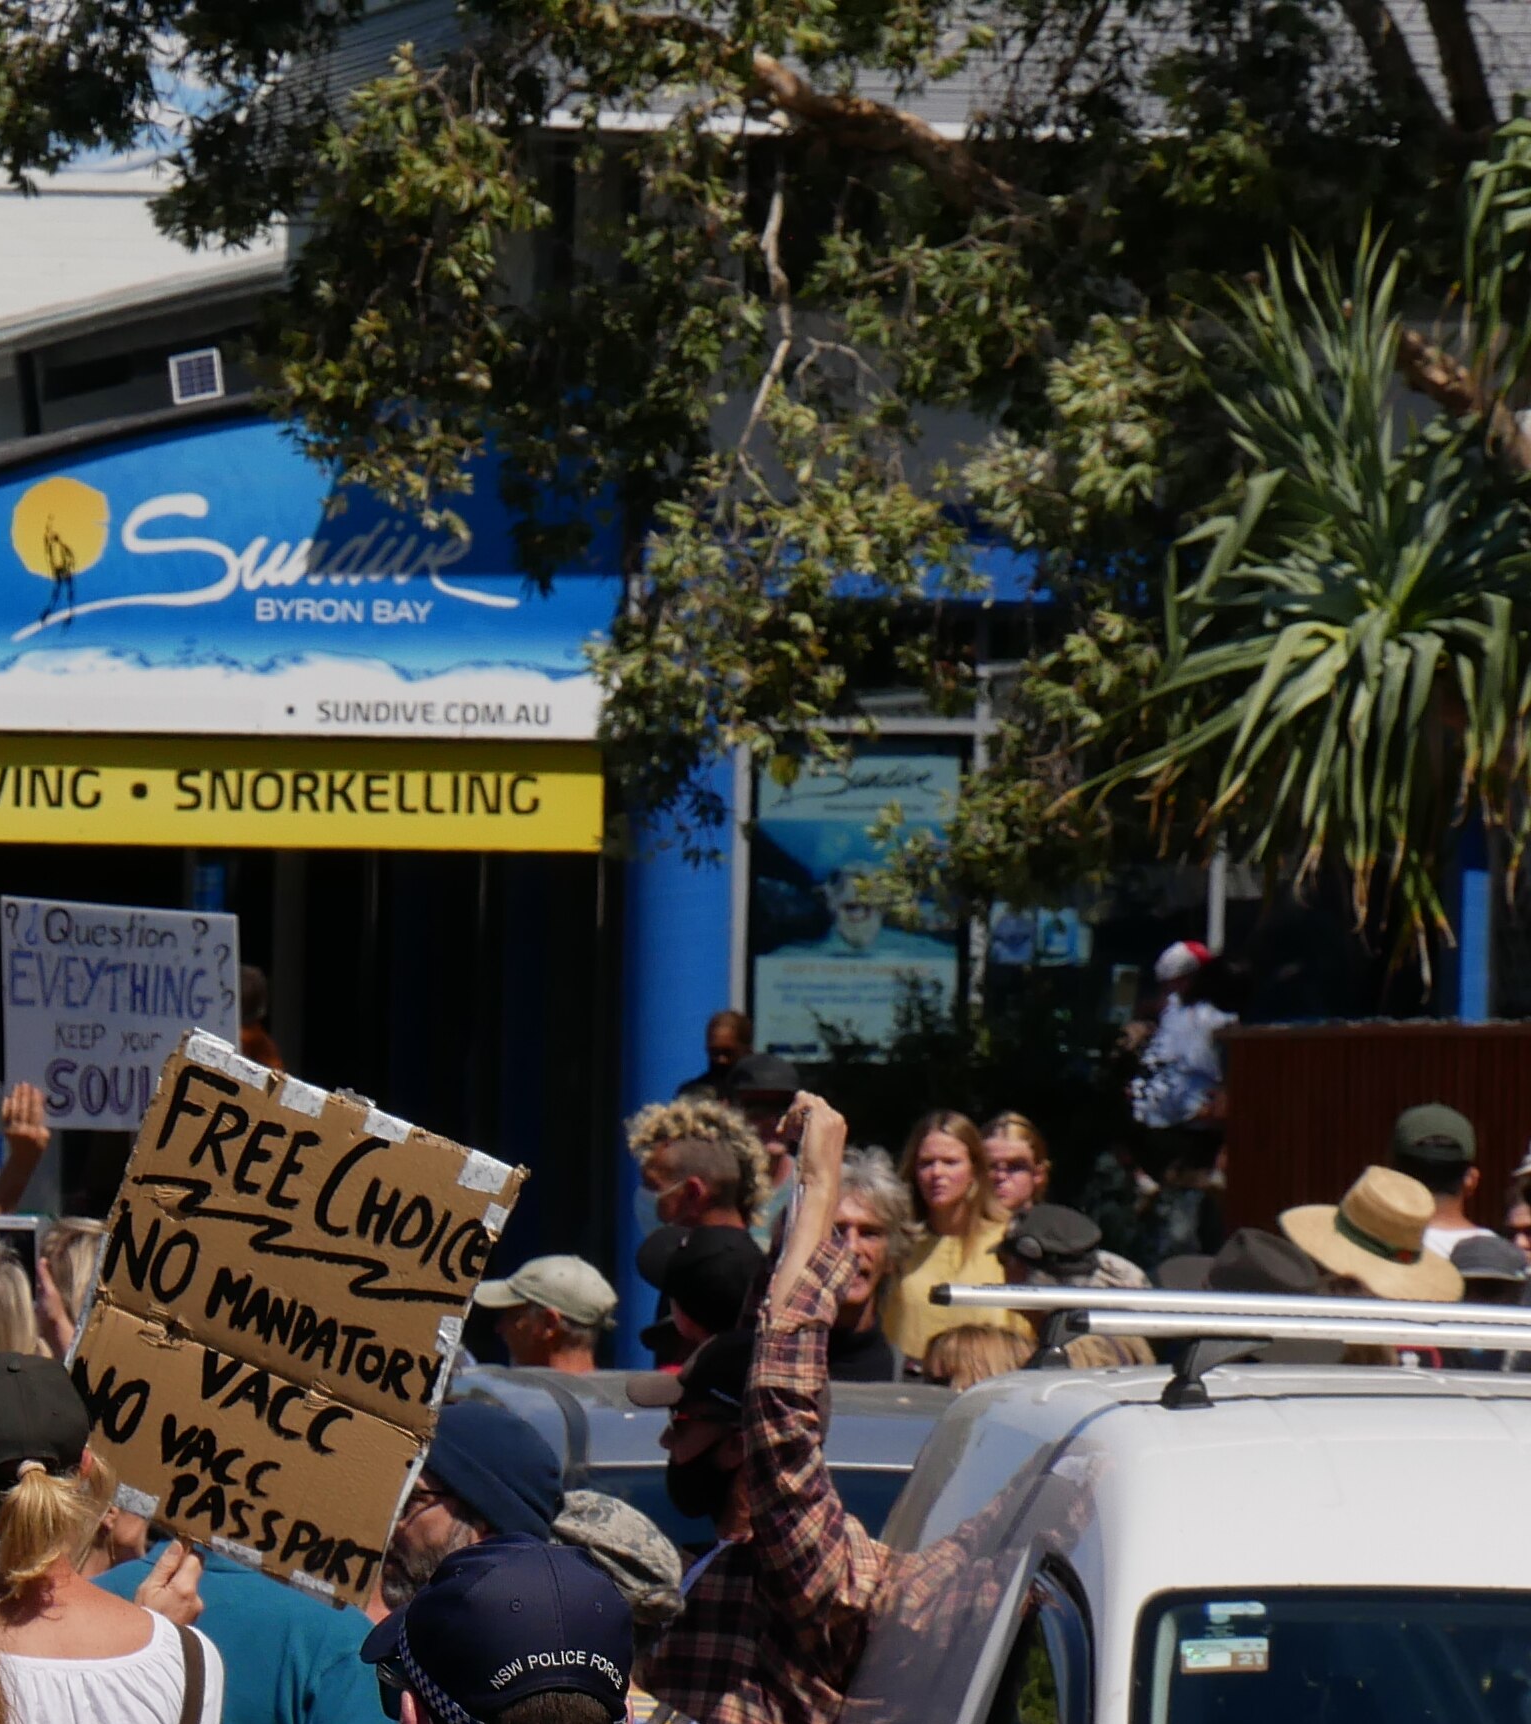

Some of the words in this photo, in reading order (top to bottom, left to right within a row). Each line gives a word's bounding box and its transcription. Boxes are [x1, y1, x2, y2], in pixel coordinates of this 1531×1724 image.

[122, 493, 519, 606] Sundive
[255, 600, 364, 623] BYRON
[372, 600, 433, 624] BAY
[316, 701, 552, 727] SUNDIVE.COM.AU
[175, 769, 541, 815] SNORKELLING
[44, 907, 179, 950] Question
[8, 950, 213, 1020] EVEYTHING
[54, 1021, 107, 1051] KEEP
[120, 1030, 163, 1057] your
[156, 1065, 321, 1210] FREE
[313, 1137, 492, 1283] CHOICE
[104, 1200, 201, 1302] NO
[204, 1266, 447, 1403] MANDATORY
[72, 1357, 151, 1444] NO
[161, 1413, 281, 1498] VACC
[201, 1348, 356, 1455] VACC
[165, 1474, 383, 1594] PASSPORT
[489, 1658, 524, 1691] NSW
[527, 1650, 587, 1670] POLICE
[589, 1653, 624, 1691] FORCE
